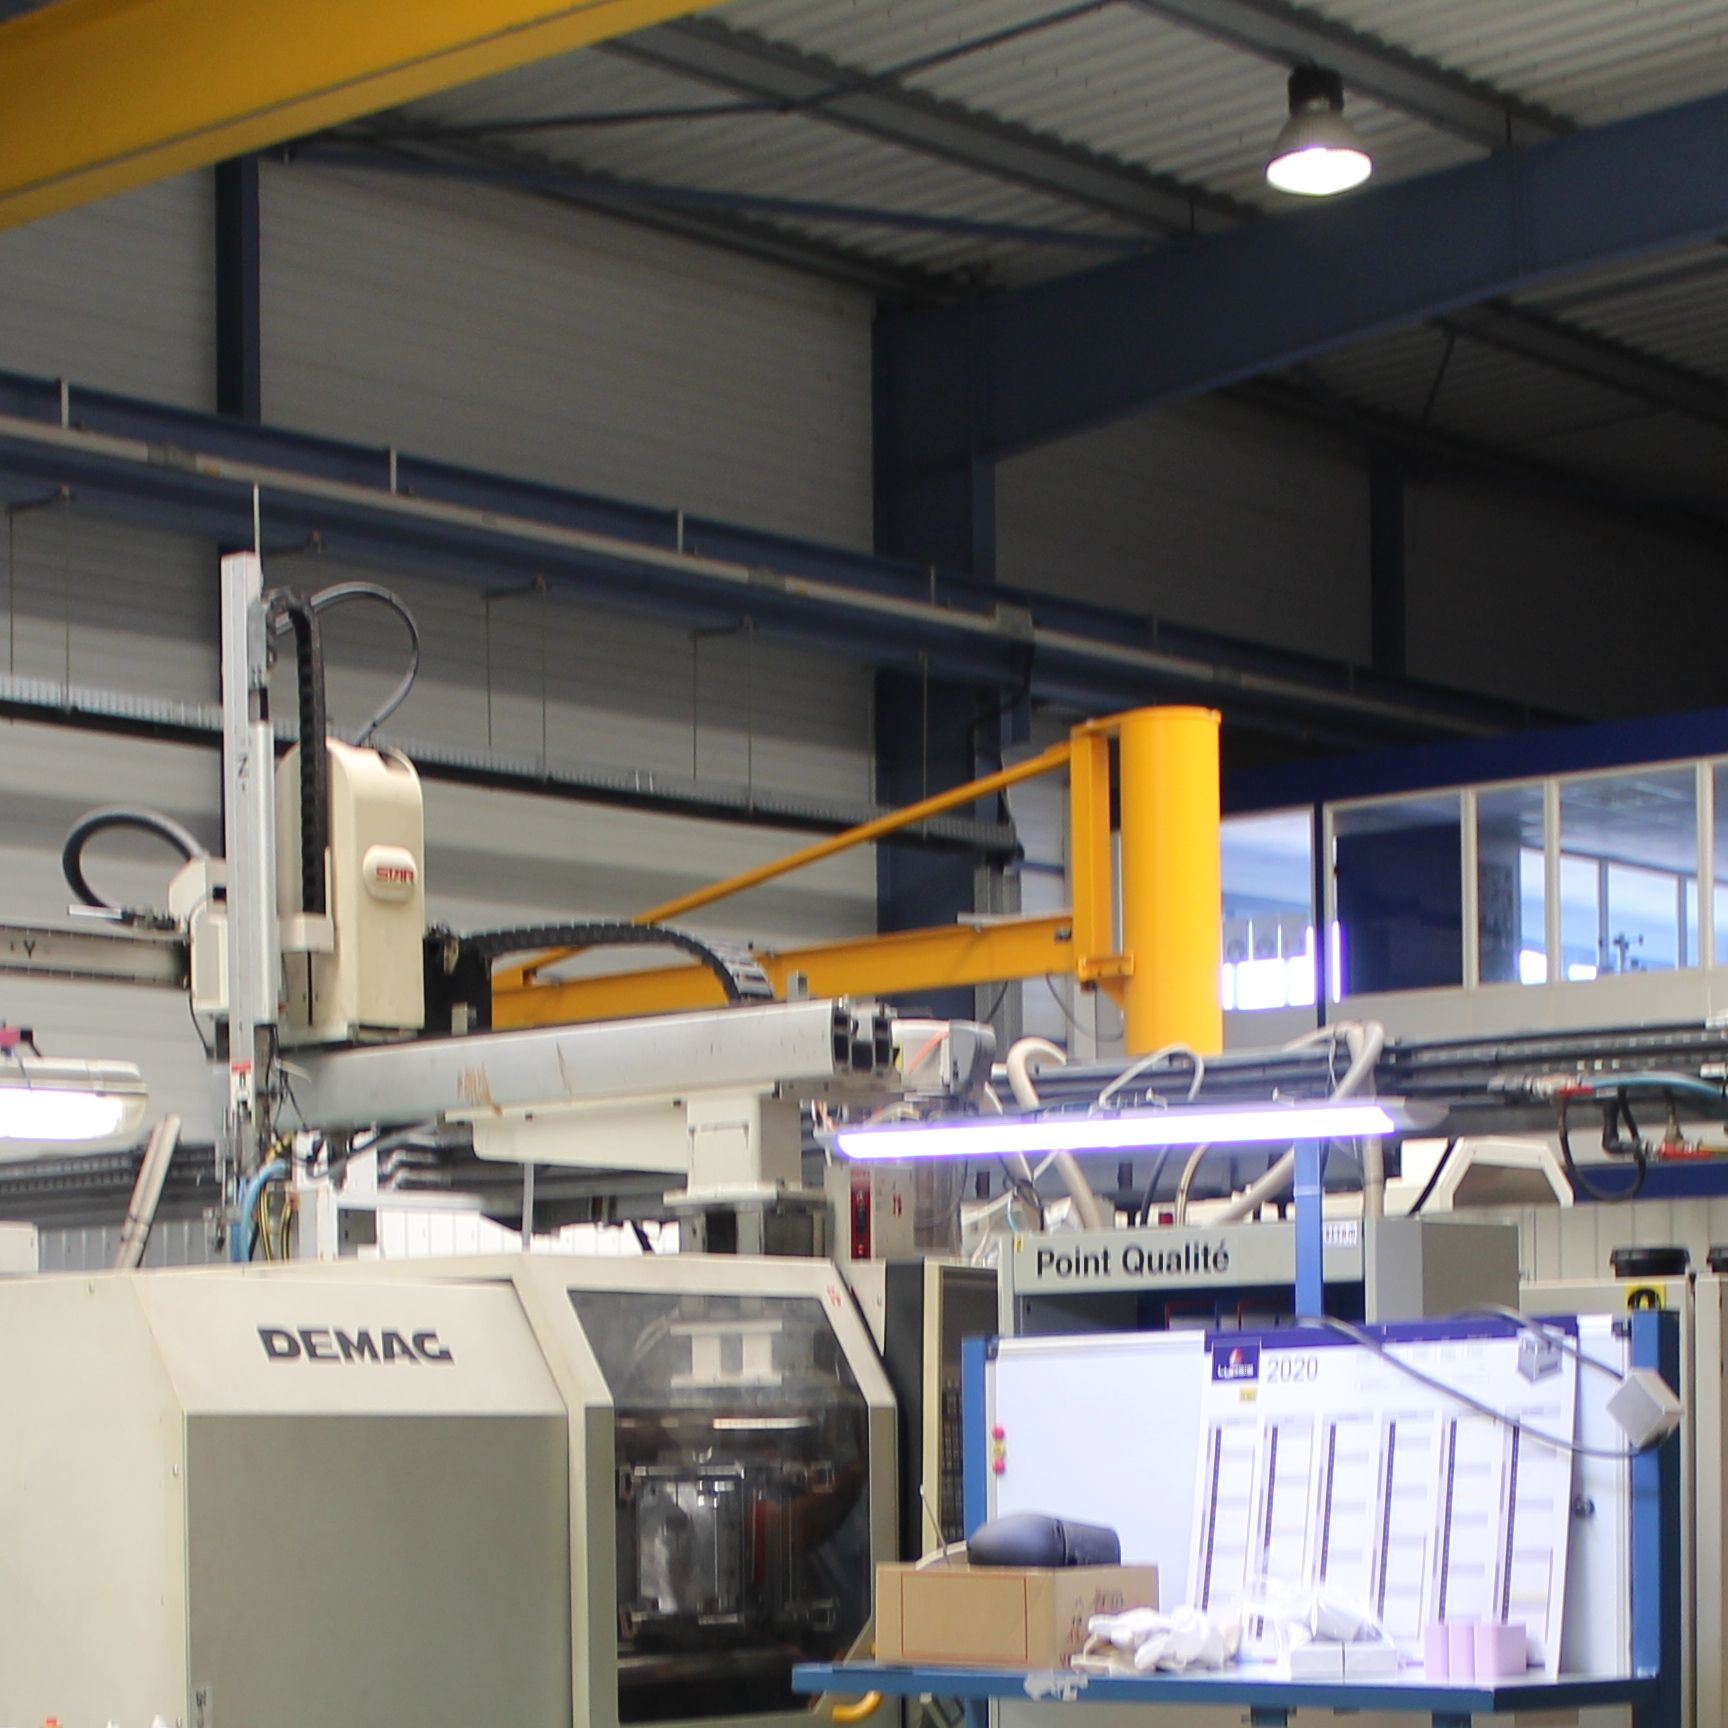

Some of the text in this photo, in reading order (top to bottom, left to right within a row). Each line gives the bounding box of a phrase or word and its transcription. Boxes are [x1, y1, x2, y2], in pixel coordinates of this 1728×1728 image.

[376, 867, 415, 884] STAR
[1037, 1238, 1229, 1278] Point Qualité
[257, 1326, 455, 1364] DEMAG
[1267, 1355, 1318, 1383] 2020
